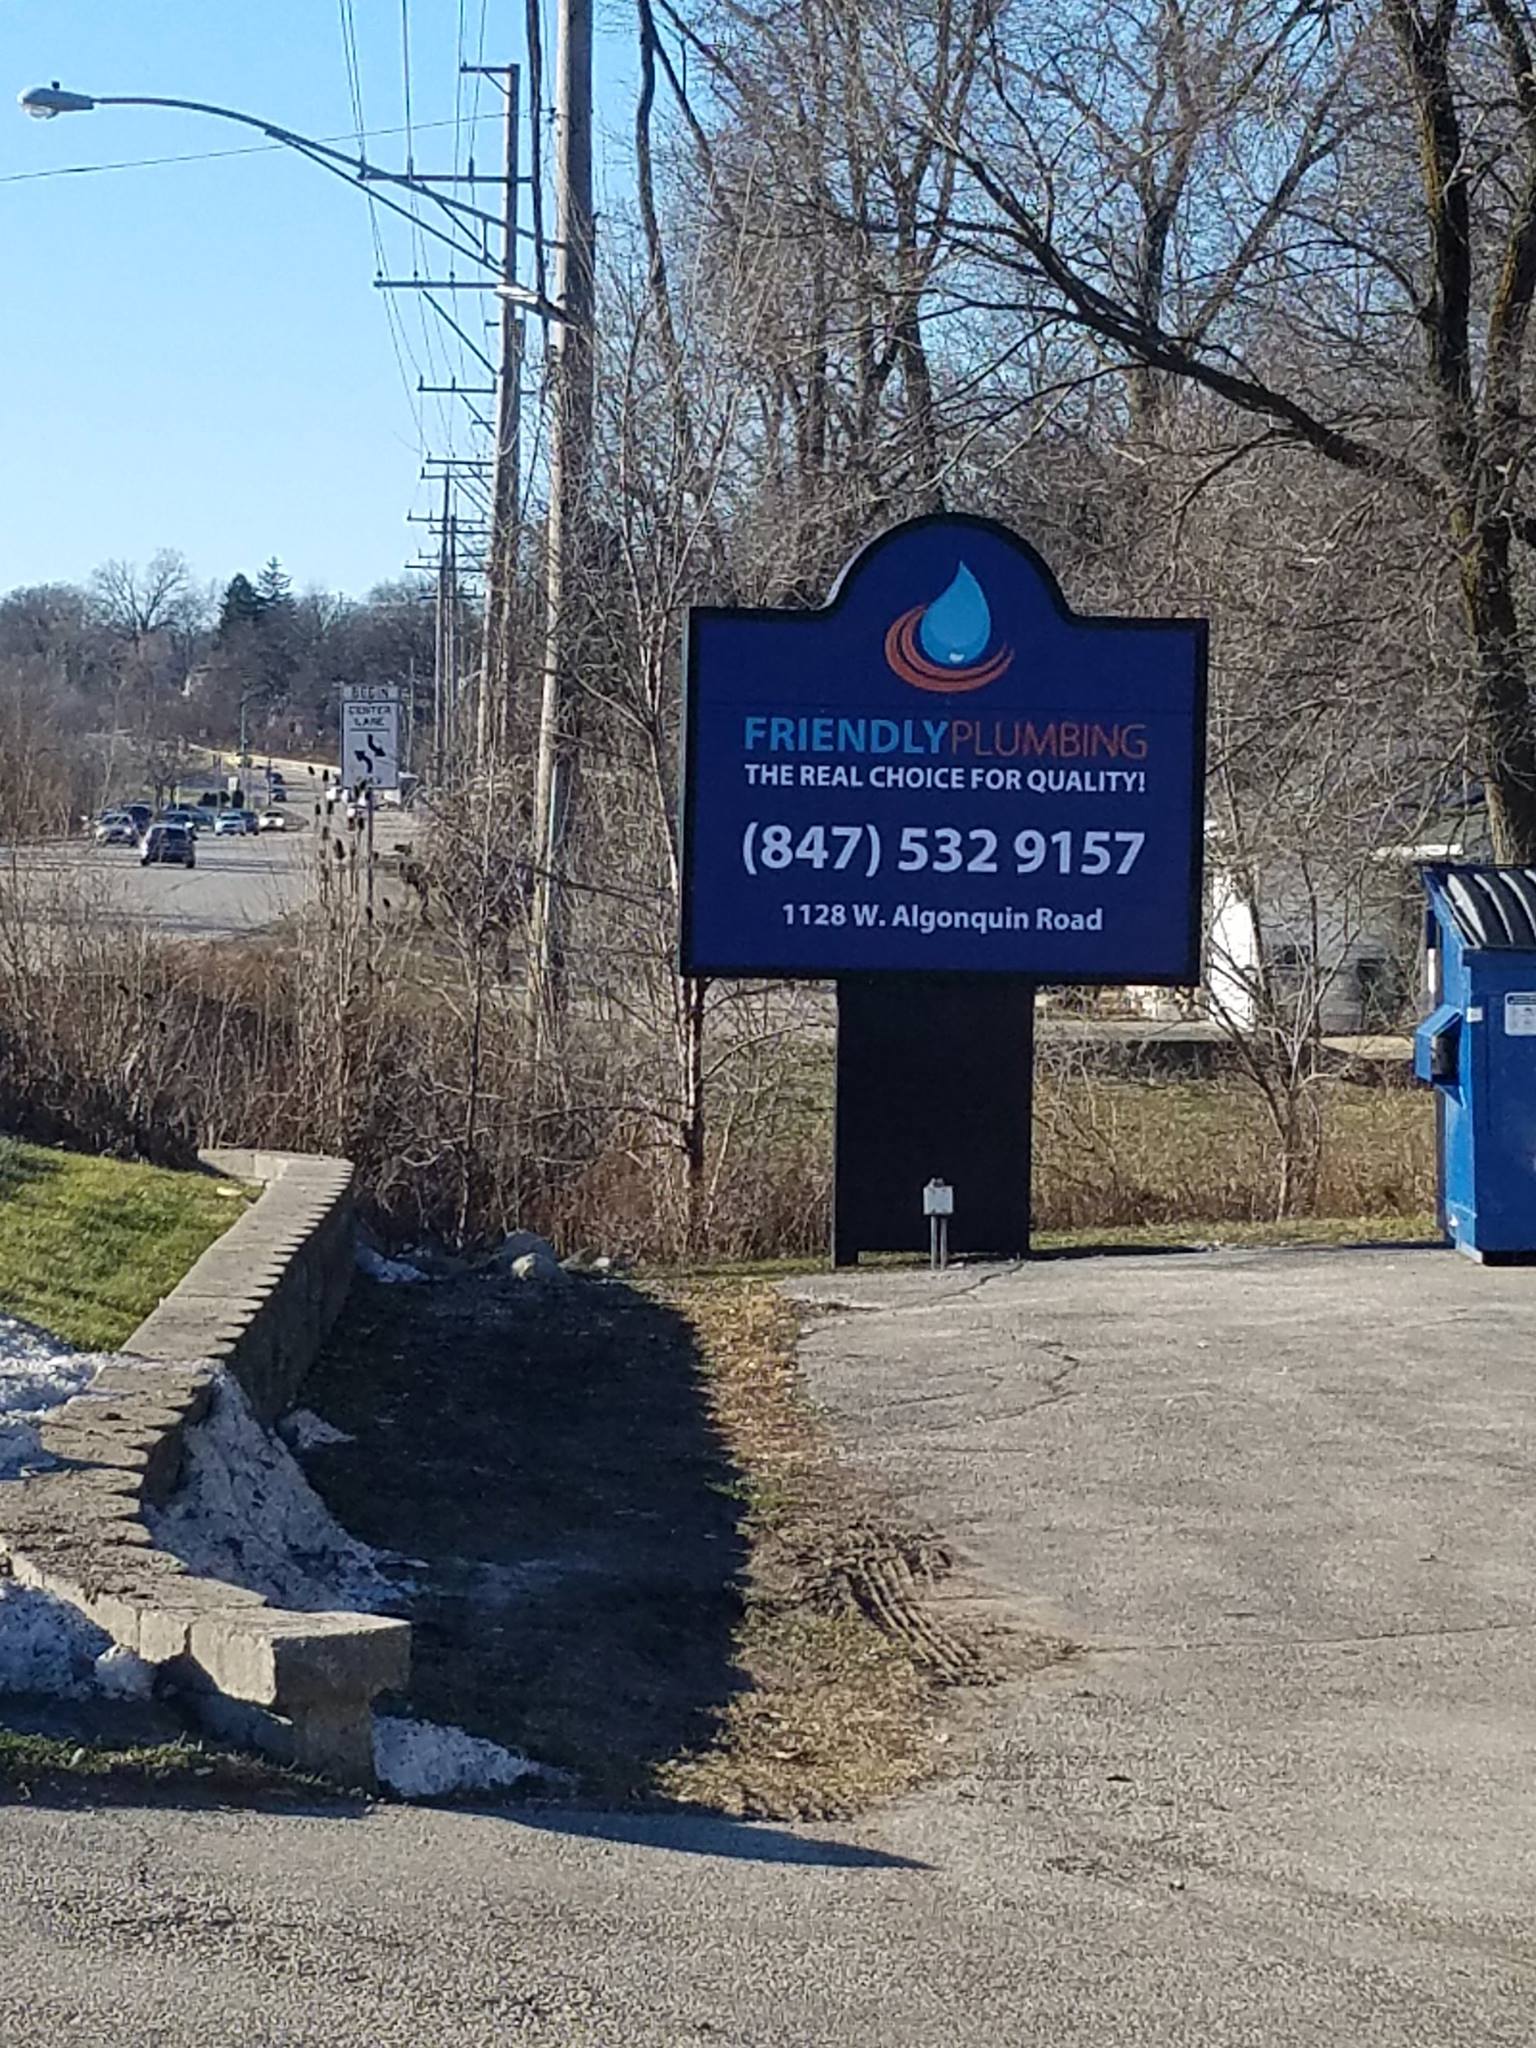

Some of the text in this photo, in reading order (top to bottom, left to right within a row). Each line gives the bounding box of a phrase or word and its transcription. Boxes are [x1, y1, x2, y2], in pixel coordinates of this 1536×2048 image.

[745, 764, 1147, 794] THE REAL CHOICE FOR QUALITY!
[742, 822, 1146, 877] (847) 532 9157
[782, 904, 1104, 934] 1128 W. Algonquin Road
